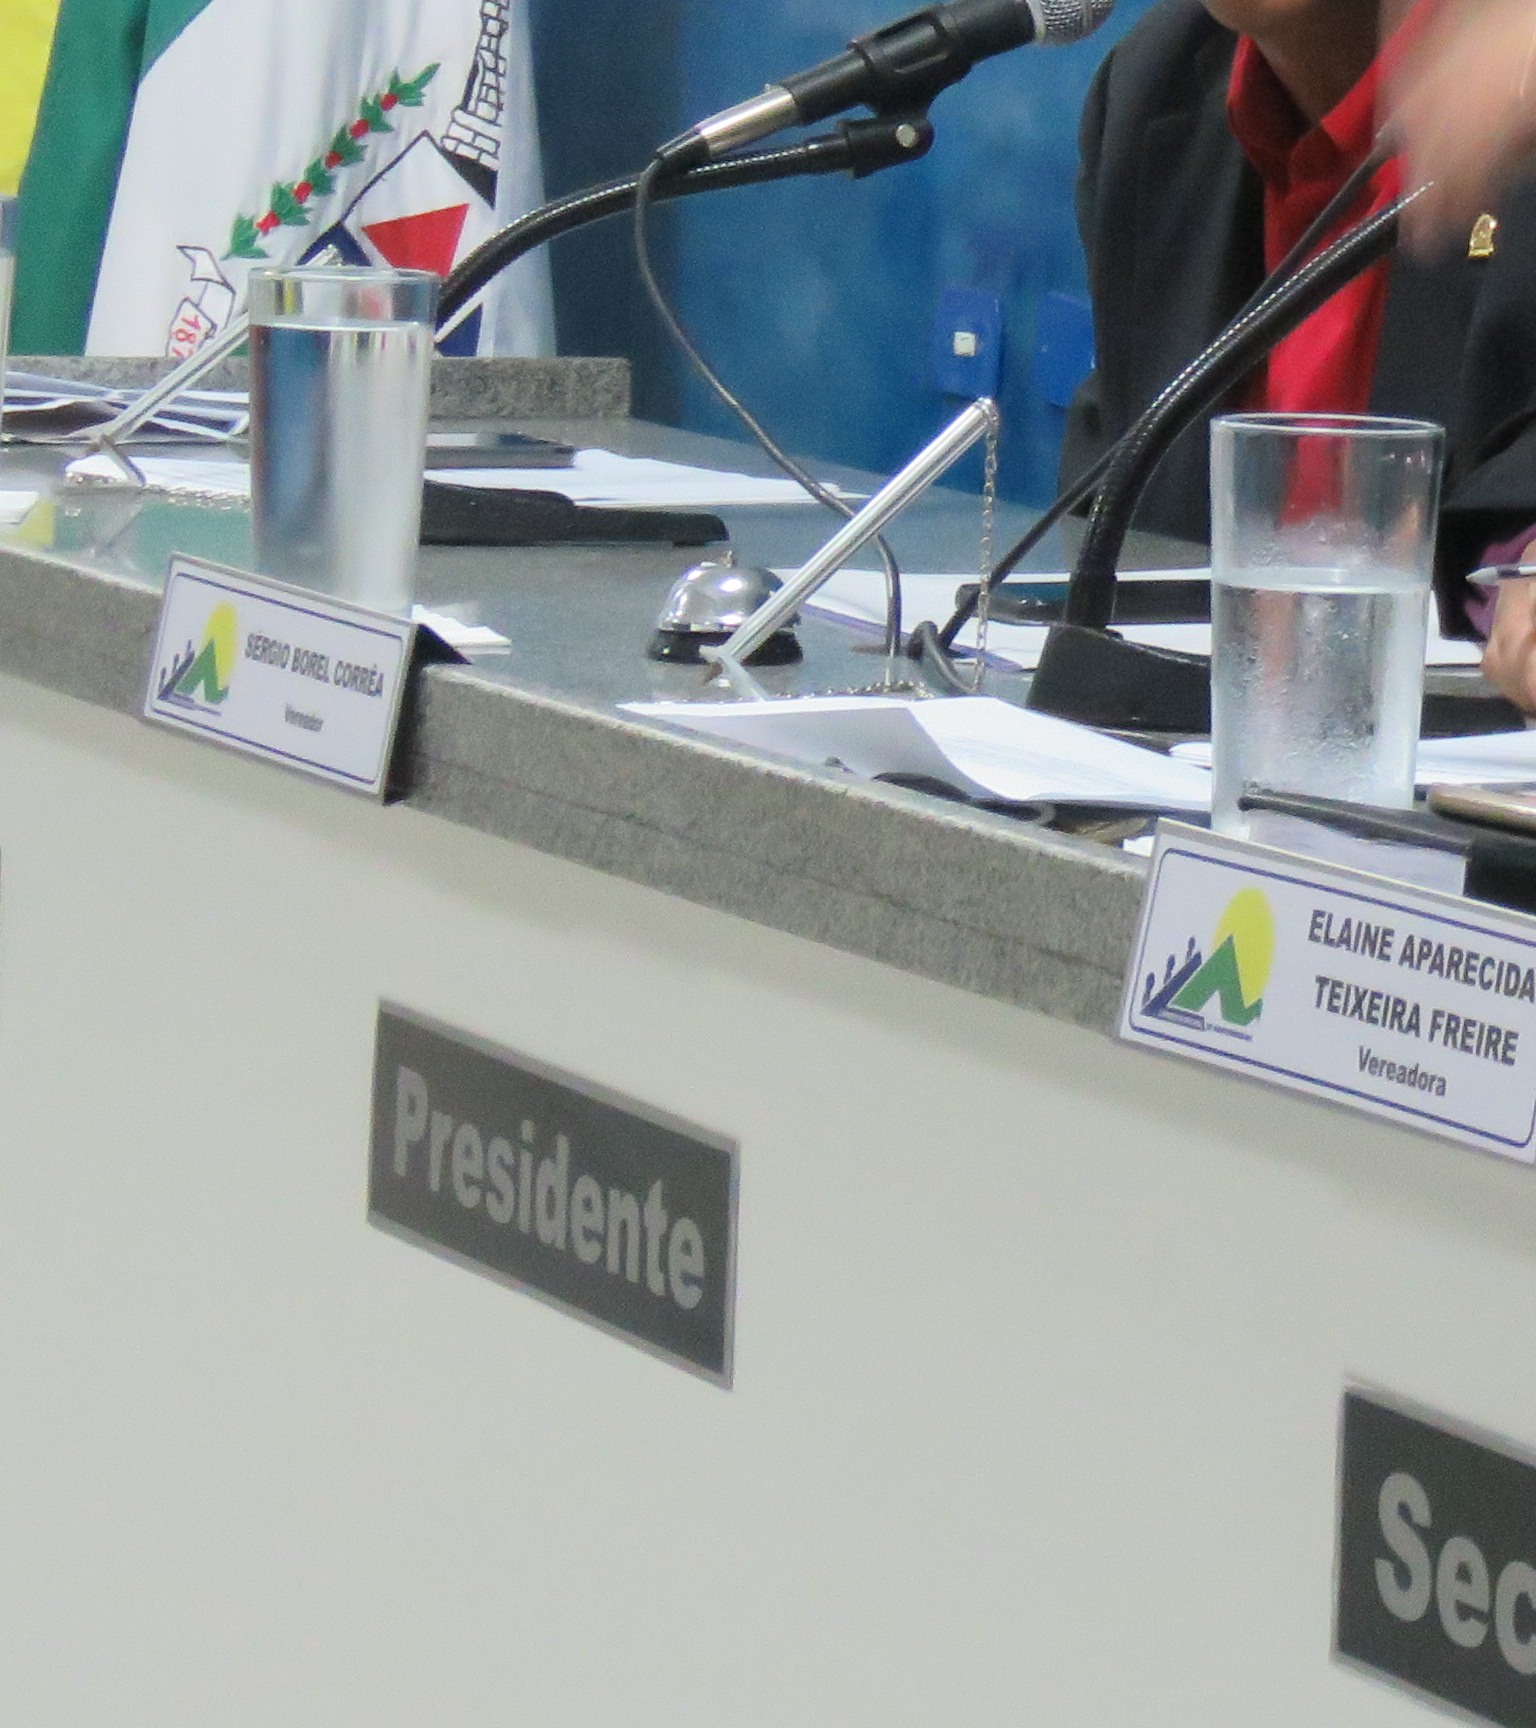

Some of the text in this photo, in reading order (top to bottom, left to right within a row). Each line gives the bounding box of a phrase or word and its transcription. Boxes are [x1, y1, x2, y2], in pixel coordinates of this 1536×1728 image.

[1307, 908, 1396, 963] ELAINE
[1313, 974, 1422, 1039] TEIXEIRA
[1427, 1006, 1520, 1068] FREIRE
[1358, 1044, 1448, 1098] Vereadora
[393, 1065, 705, 1310] Presidente
